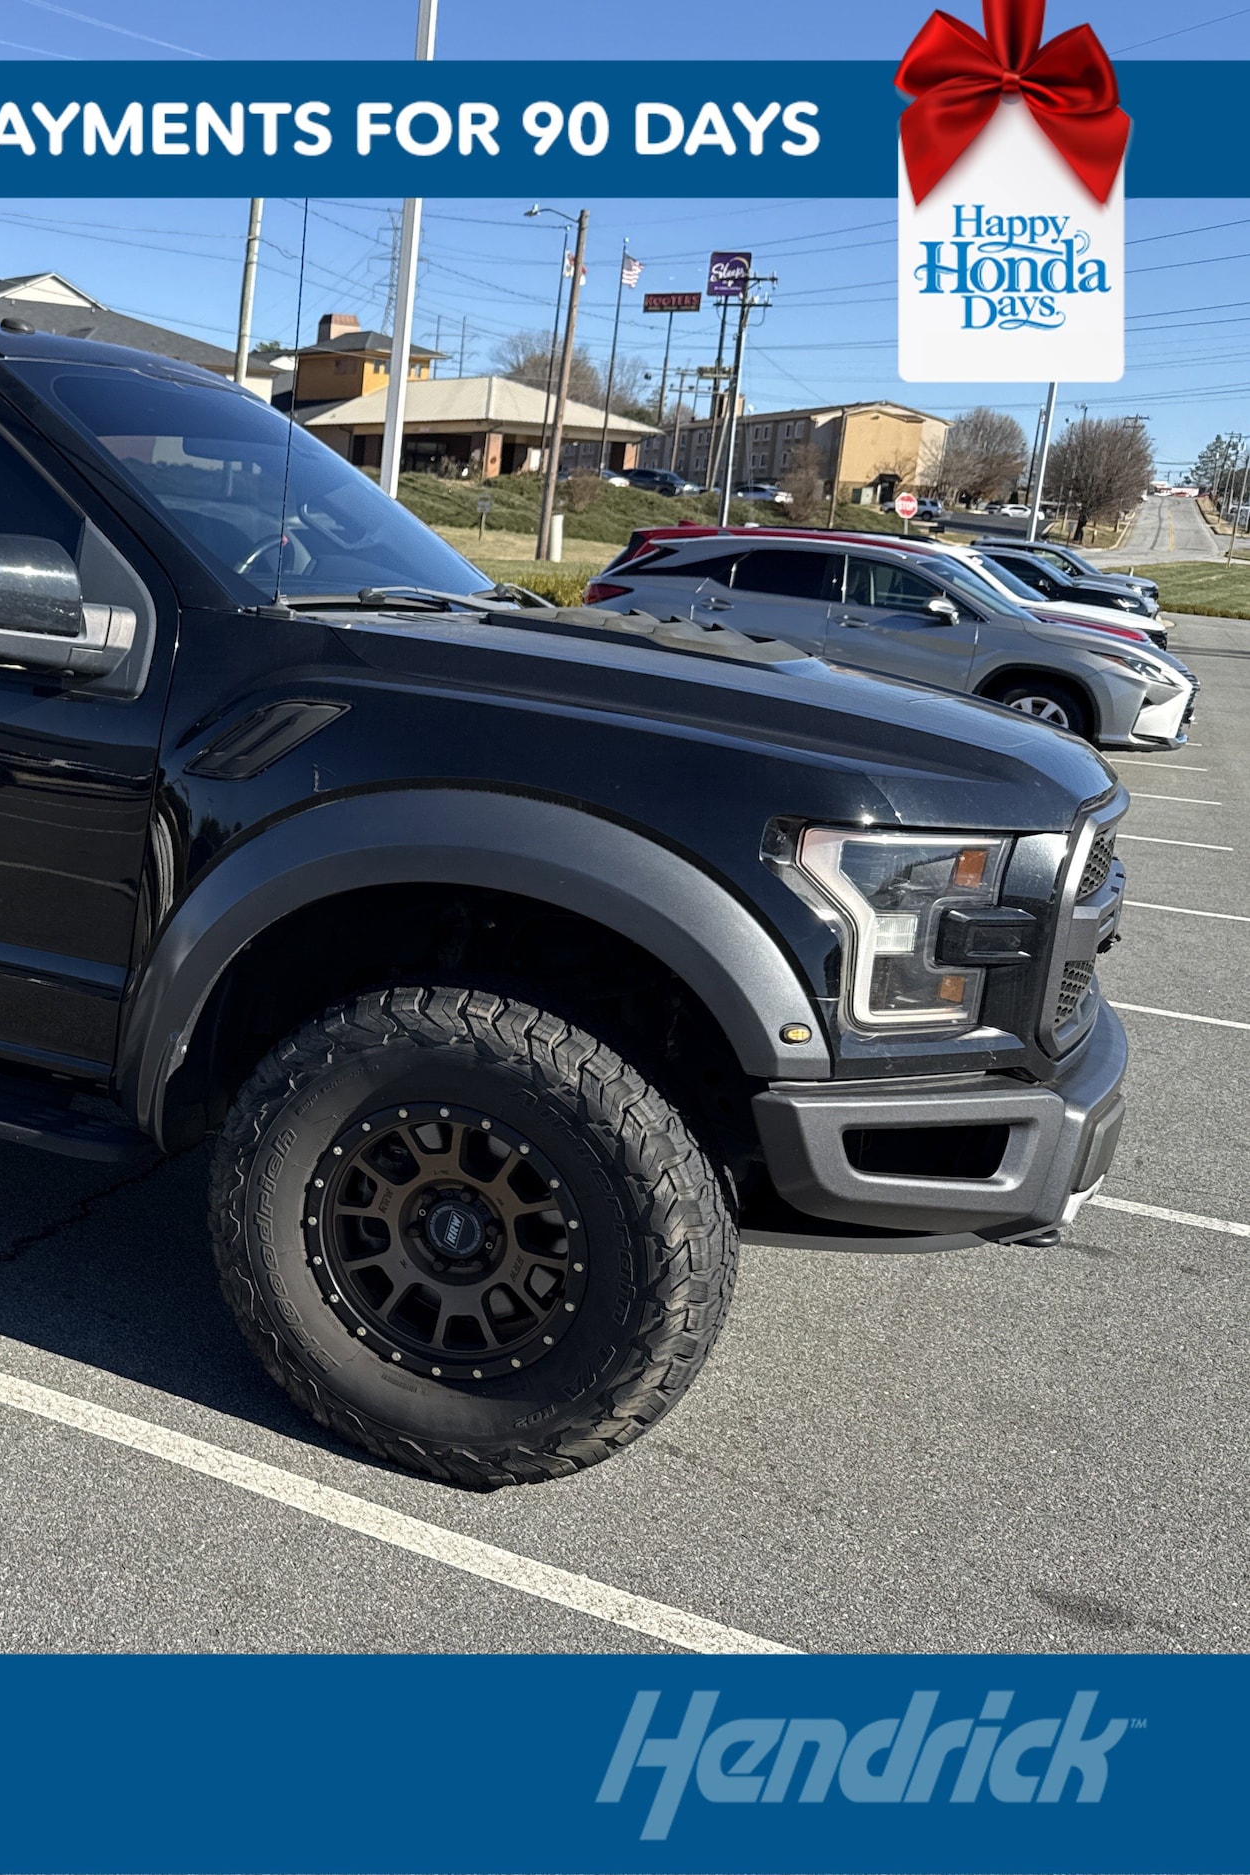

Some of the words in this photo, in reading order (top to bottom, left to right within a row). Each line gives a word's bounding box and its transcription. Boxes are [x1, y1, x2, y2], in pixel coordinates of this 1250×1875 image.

[646, 295, 699, 306] HOOTERS
[897, 499, 917, 511] STOP
[446, 1214, 462, 1245] RRW
[253, 1128, 343, 1373] BFGoodrich
